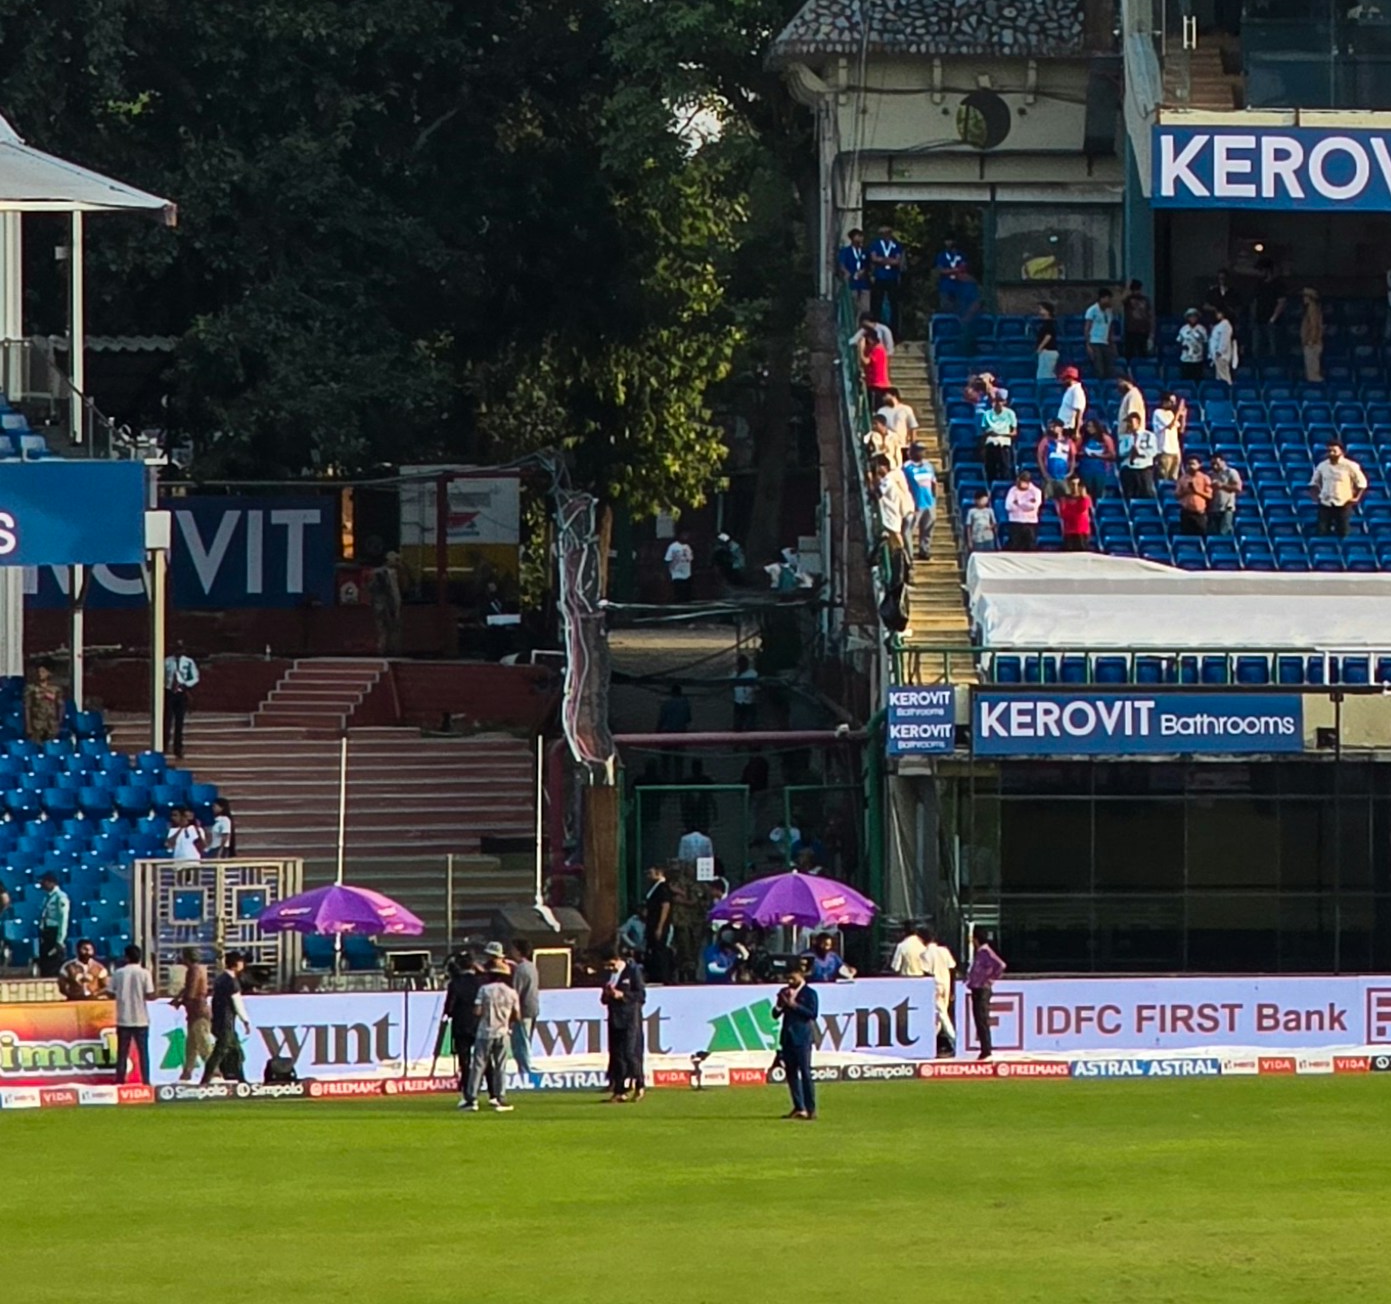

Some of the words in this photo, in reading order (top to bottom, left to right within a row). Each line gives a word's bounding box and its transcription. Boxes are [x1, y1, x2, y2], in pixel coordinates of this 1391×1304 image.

[889, 691, 951, 706] KEROVIT
[981, 700, 1155, 737] KEROVIT
[1160, 712, 1294, 736] Bathrooms
[890, 724, 952, 738] KEROVIT
[1036, 1004, 1122, 1035] IDFC
[1136, 1003, 1243, 1033] FIRST
[1257, 1002, 1347, 1032] Bank
[534, 1005, 671, 1055] wit
[863, 1064, 914, 1079] Simpolo
[934, 1064, 994, 1076] FREEMANS
[1010, 1063, 1069, 1076] FREEMANS
[1075, 1060, 1143, 1076] ASTRAL
[1149, 1059, 1218, 1075] ASTRAL
[1261, 1060, 1291, 1070] VIDA
[1337, 1059, 1365, 1070] VIDA
[657, 1070, 687, 1082] VIDA
[732, 1069, 762, 1081] VIDA
[120, 1088, 151, 1099] VIDA
